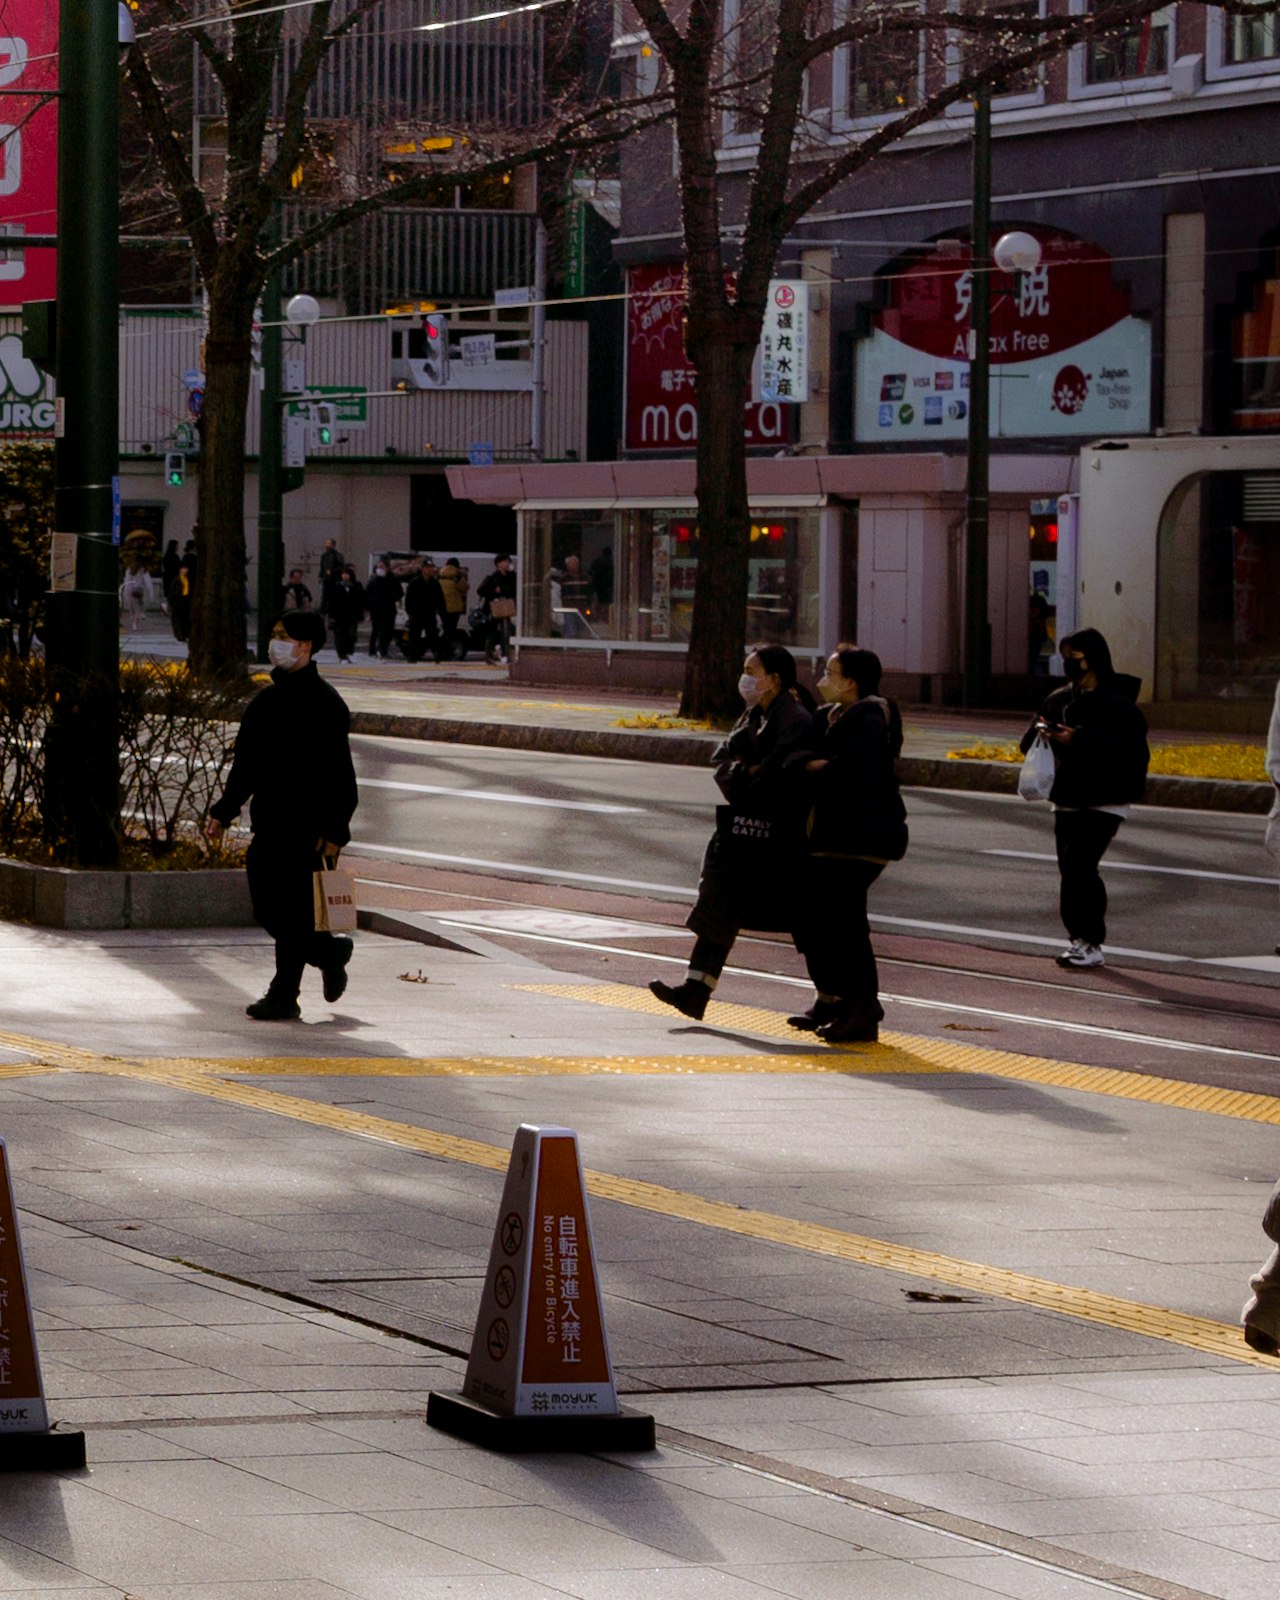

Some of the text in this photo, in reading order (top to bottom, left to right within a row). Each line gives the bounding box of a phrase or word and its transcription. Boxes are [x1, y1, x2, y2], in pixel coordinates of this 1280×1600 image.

[1013, 330, 1050, 352] Free
[543, 1215, 558, 1344] No entry for Bicycle
[558, 1215, 582, 1364] 自転車進入禁止
